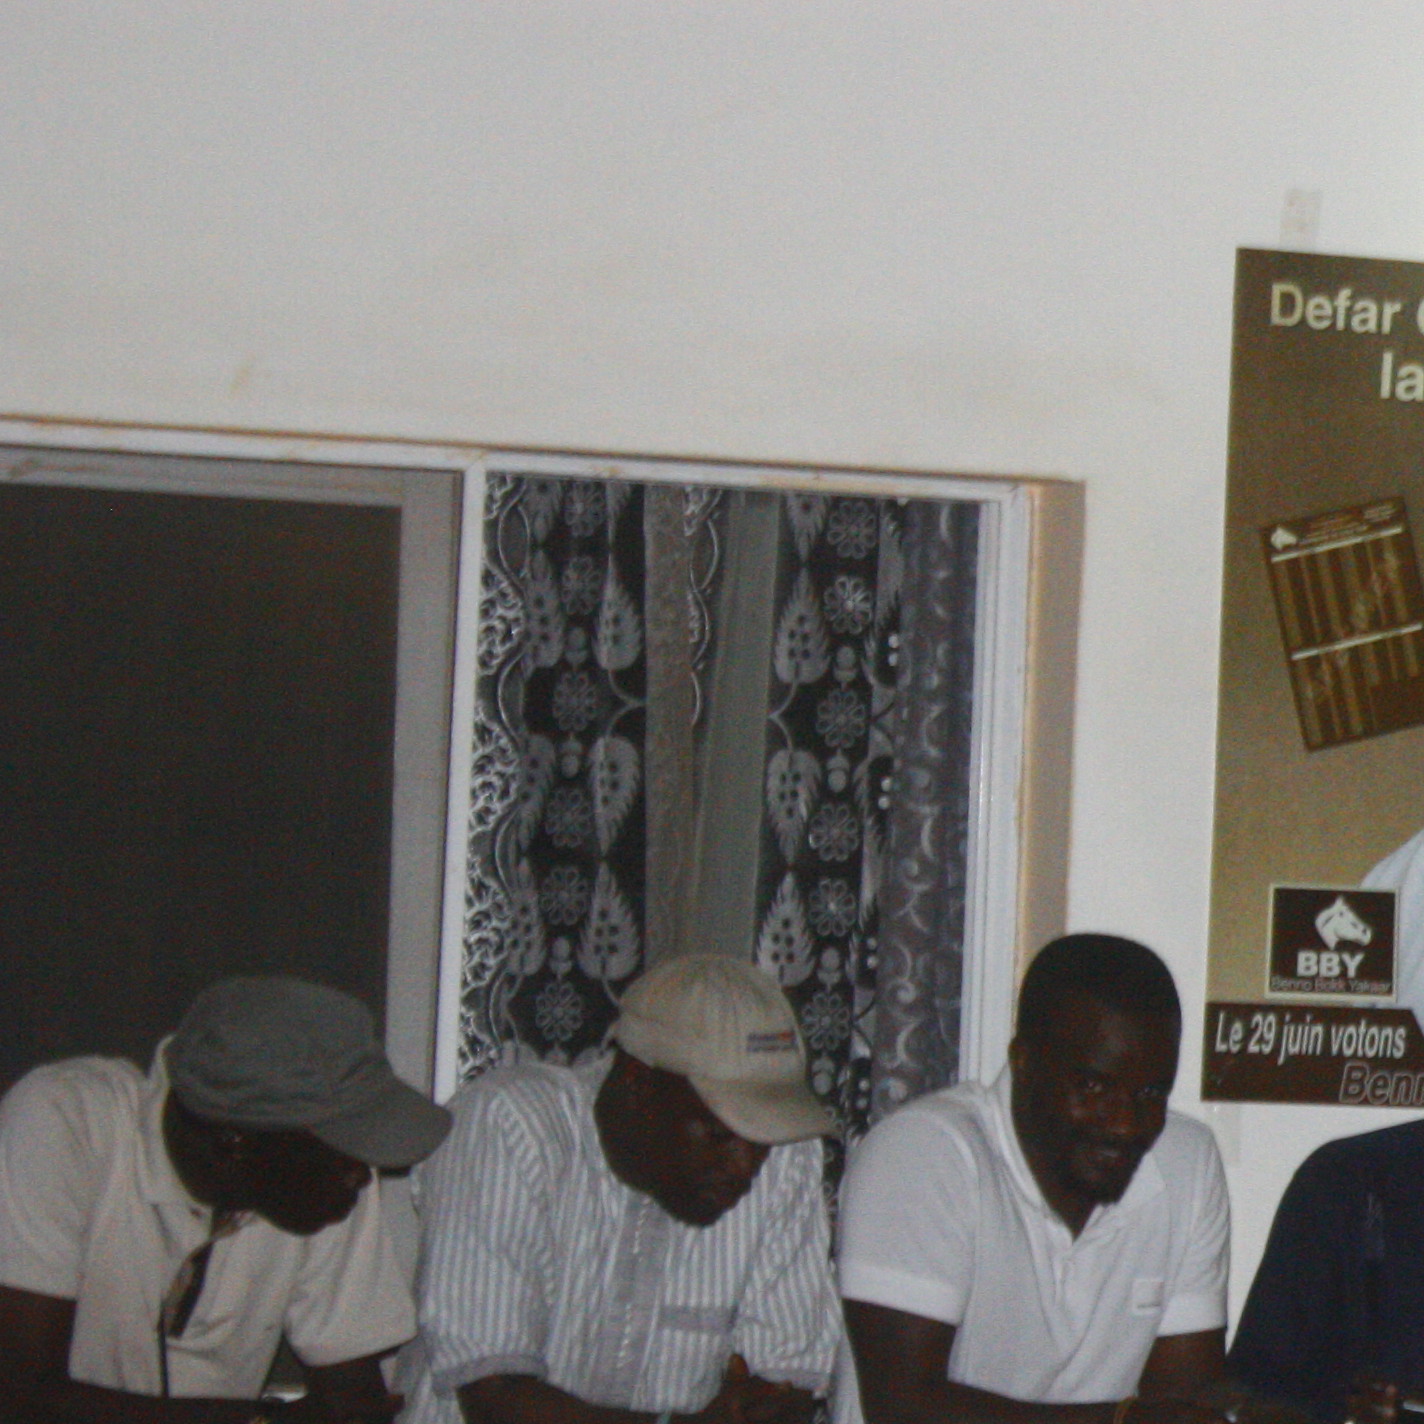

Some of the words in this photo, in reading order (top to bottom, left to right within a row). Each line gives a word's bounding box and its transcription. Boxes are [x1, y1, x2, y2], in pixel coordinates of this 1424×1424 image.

[1269, 282, 1401, 335] Defar
[1297, 949, 1364, 978] BBY
[1215, 1011, 1242, 1054] Le
[1249, 1013, 1275, 1053] 29
[1278, 1014, 1324, 1066] juin
[1330, 1020, 1406, 1059] votons
